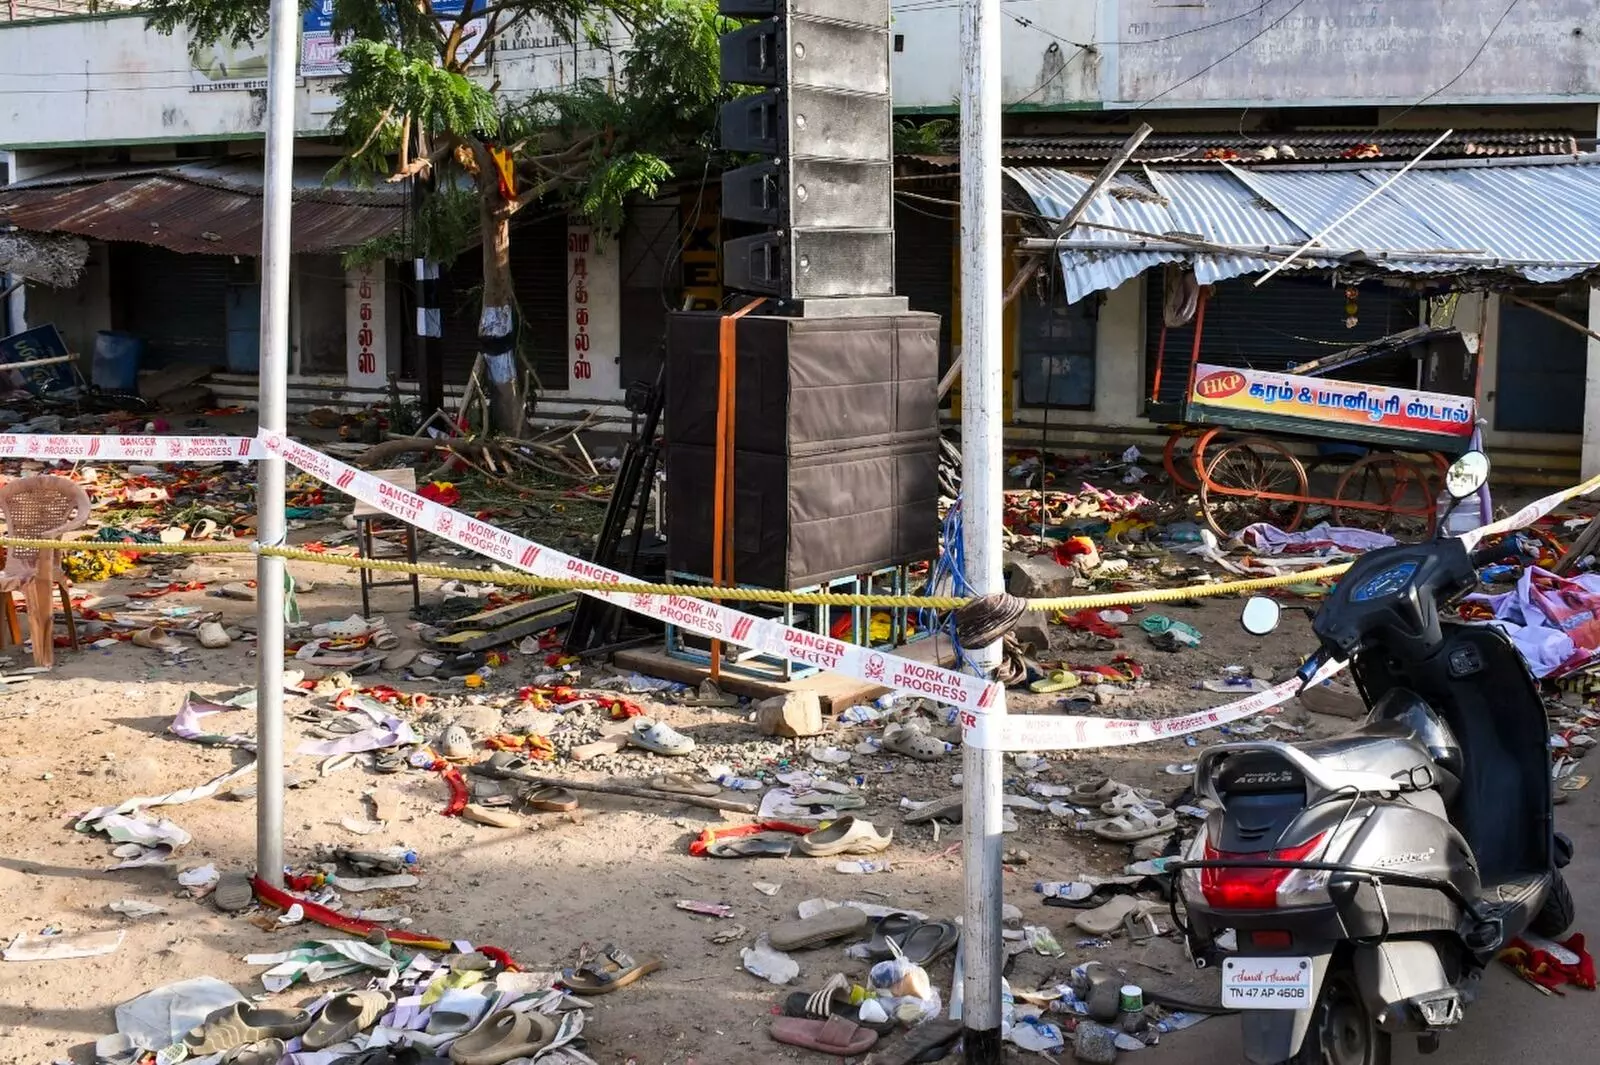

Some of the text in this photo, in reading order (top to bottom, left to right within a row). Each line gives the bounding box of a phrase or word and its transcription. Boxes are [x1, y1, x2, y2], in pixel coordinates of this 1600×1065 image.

[1202, 374, 1241, 395] HKP
[1298, 387, 1313, 403] &
[1318, 391, 1400, 420] பானிபூரி
[1407, 397, 1469, 422] ஸ்டால்
[44, 446, 84, 455] PROGRESS
[119, 437, 157, 446] DANGER
[187, 447, 232, 456] PROGRESS
[191, 438, 228, 446] WORK IN
[292, 444, 319, 463] WORK
[282, 450, 331, 480] PROGRESS
[379, 483, 425, 511] DANGER
[458, 530, 514, 560] PROGRESS
[465, 520, 512, 547] WORK IN
[567, 559, 620, 585] DANGER
[659, 604, 723, 634] PROGRESS
[669, 594, 719, 620] WORK IN
[784, 629, 845, 657] DANGER
[788, 644, 841, 669] खतरा
[903, 662, 962, 687] WORK IN
[894, 674, 968, 703] PROGRESS
[1230, 988, 1243, 998] TN
[1246, 988, 1258, 998] 47
[1260, 988, 1275, 998] AP
